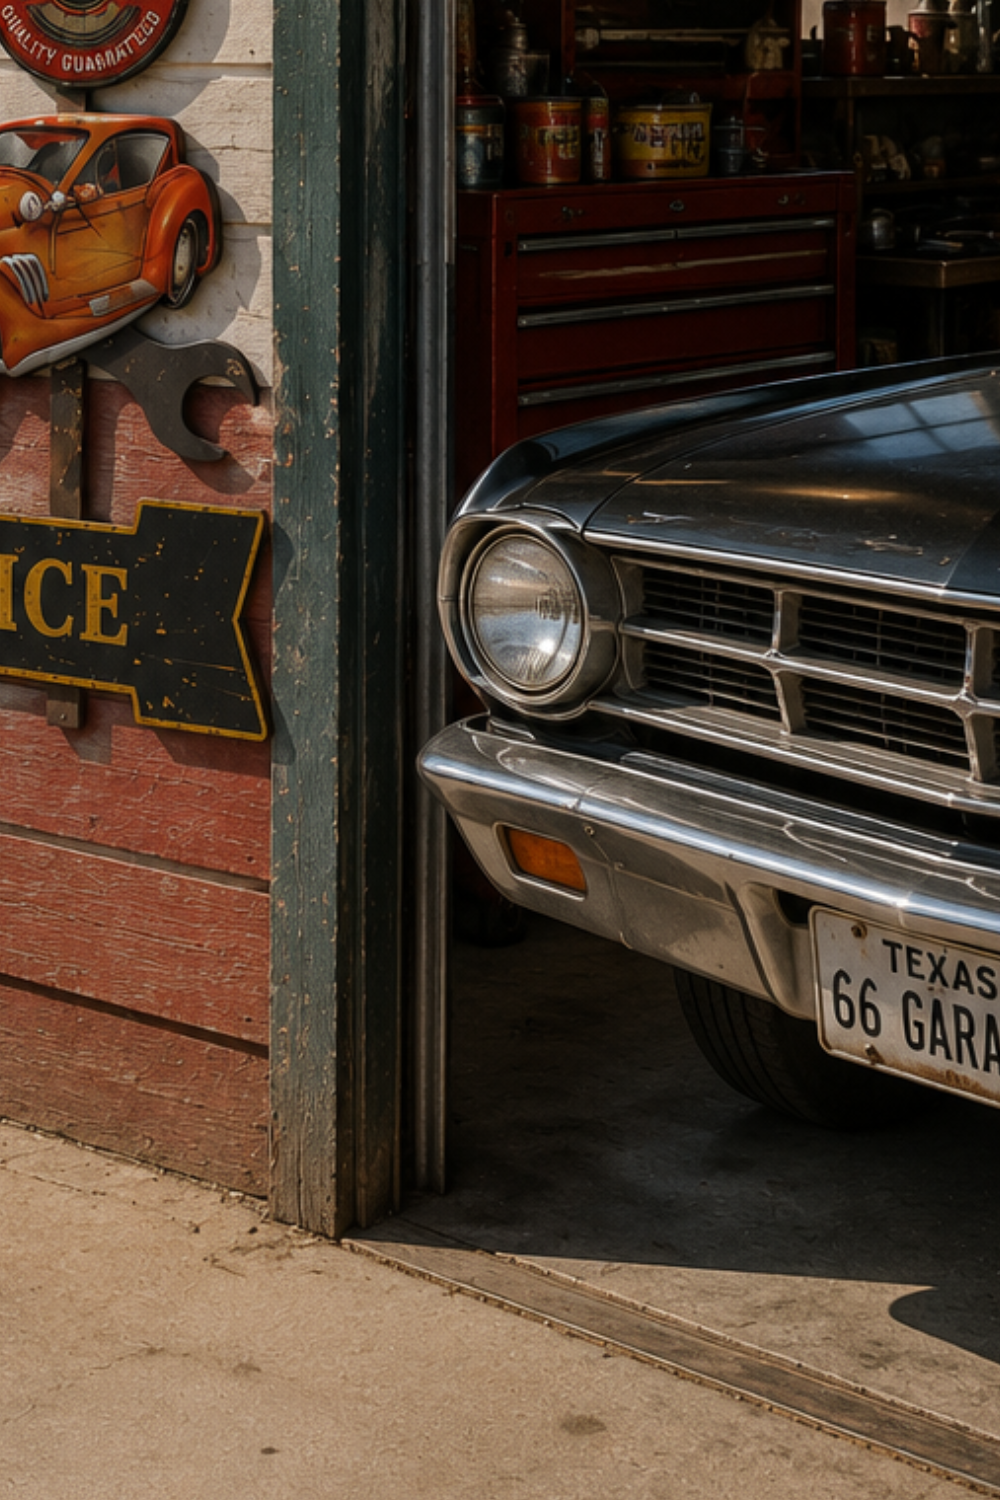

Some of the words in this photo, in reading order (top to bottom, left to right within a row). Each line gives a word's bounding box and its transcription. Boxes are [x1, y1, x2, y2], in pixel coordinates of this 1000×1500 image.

[882, 938, 999, 1001] TEXAS
[833, 968, 882, 1038] 66
[902, 990, 1000, 1076] GARA
